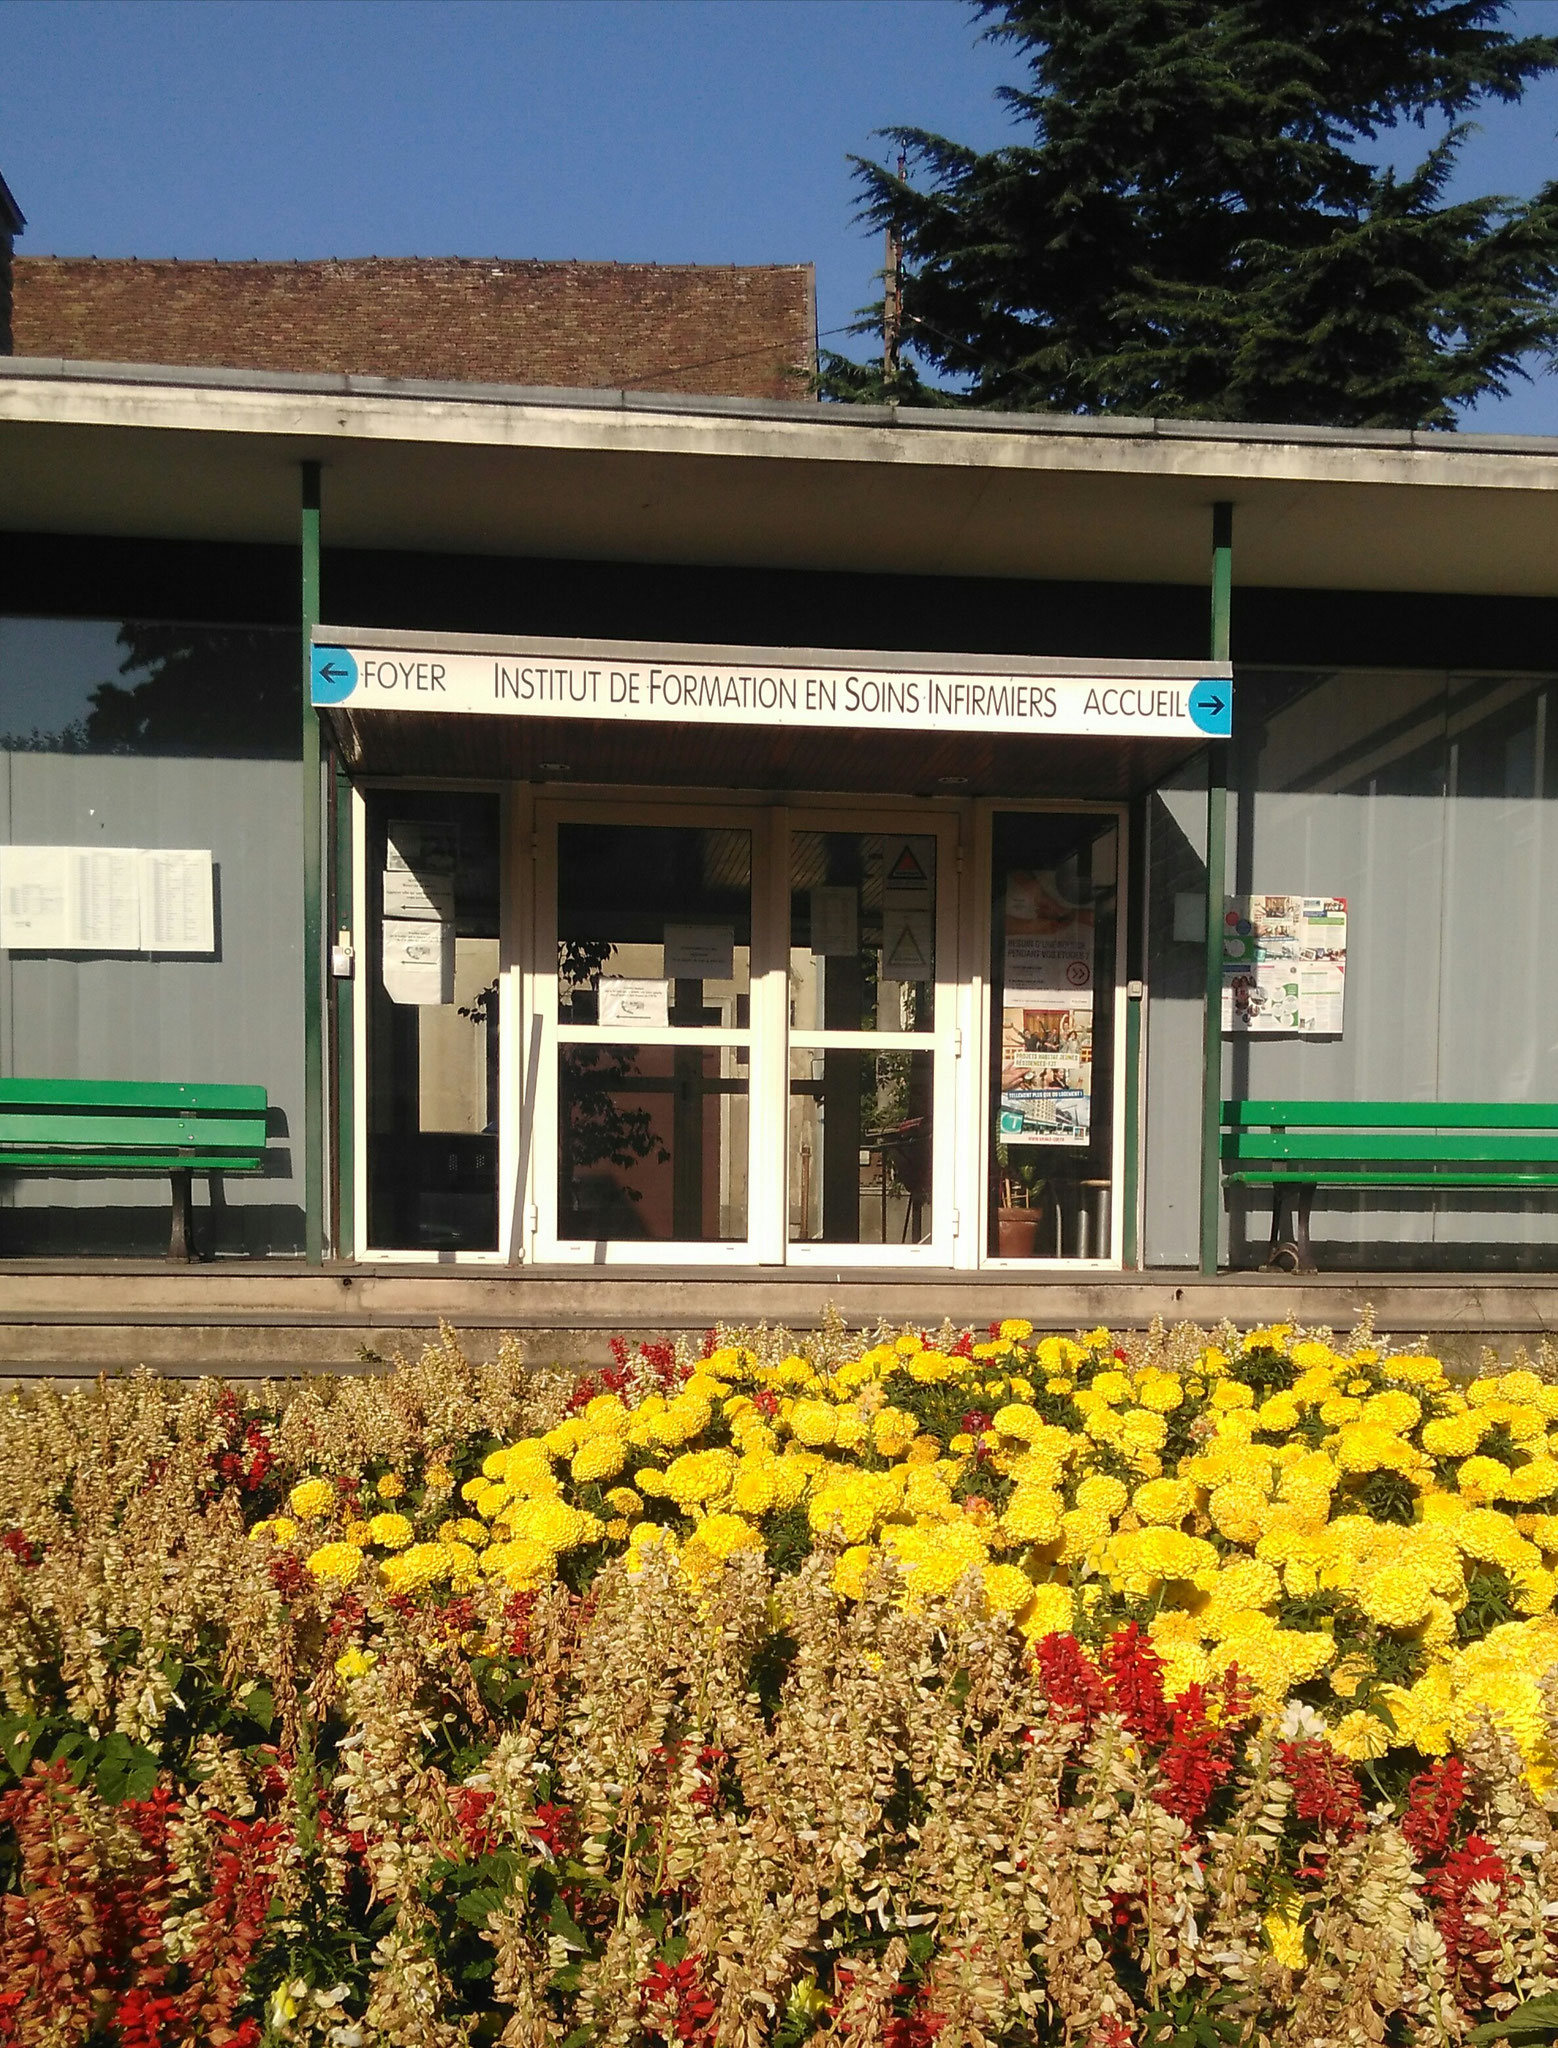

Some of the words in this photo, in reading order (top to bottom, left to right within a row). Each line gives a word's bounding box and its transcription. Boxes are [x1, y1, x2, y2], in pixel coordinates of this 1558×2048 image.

[363, 660, 447, 692] FOYER
[494, 661, 602, 702] INSTITUT
[609, 671, 641, 704] DE
[649, 669, 797, 709] FORMATION
[805, 679, 837, 711] EN
[844, 676, 920, 714] SOINS
[928, 678, 1058, 718] INFIRMIERS
[1082, 688, 1186, 718] ACCUEIL
